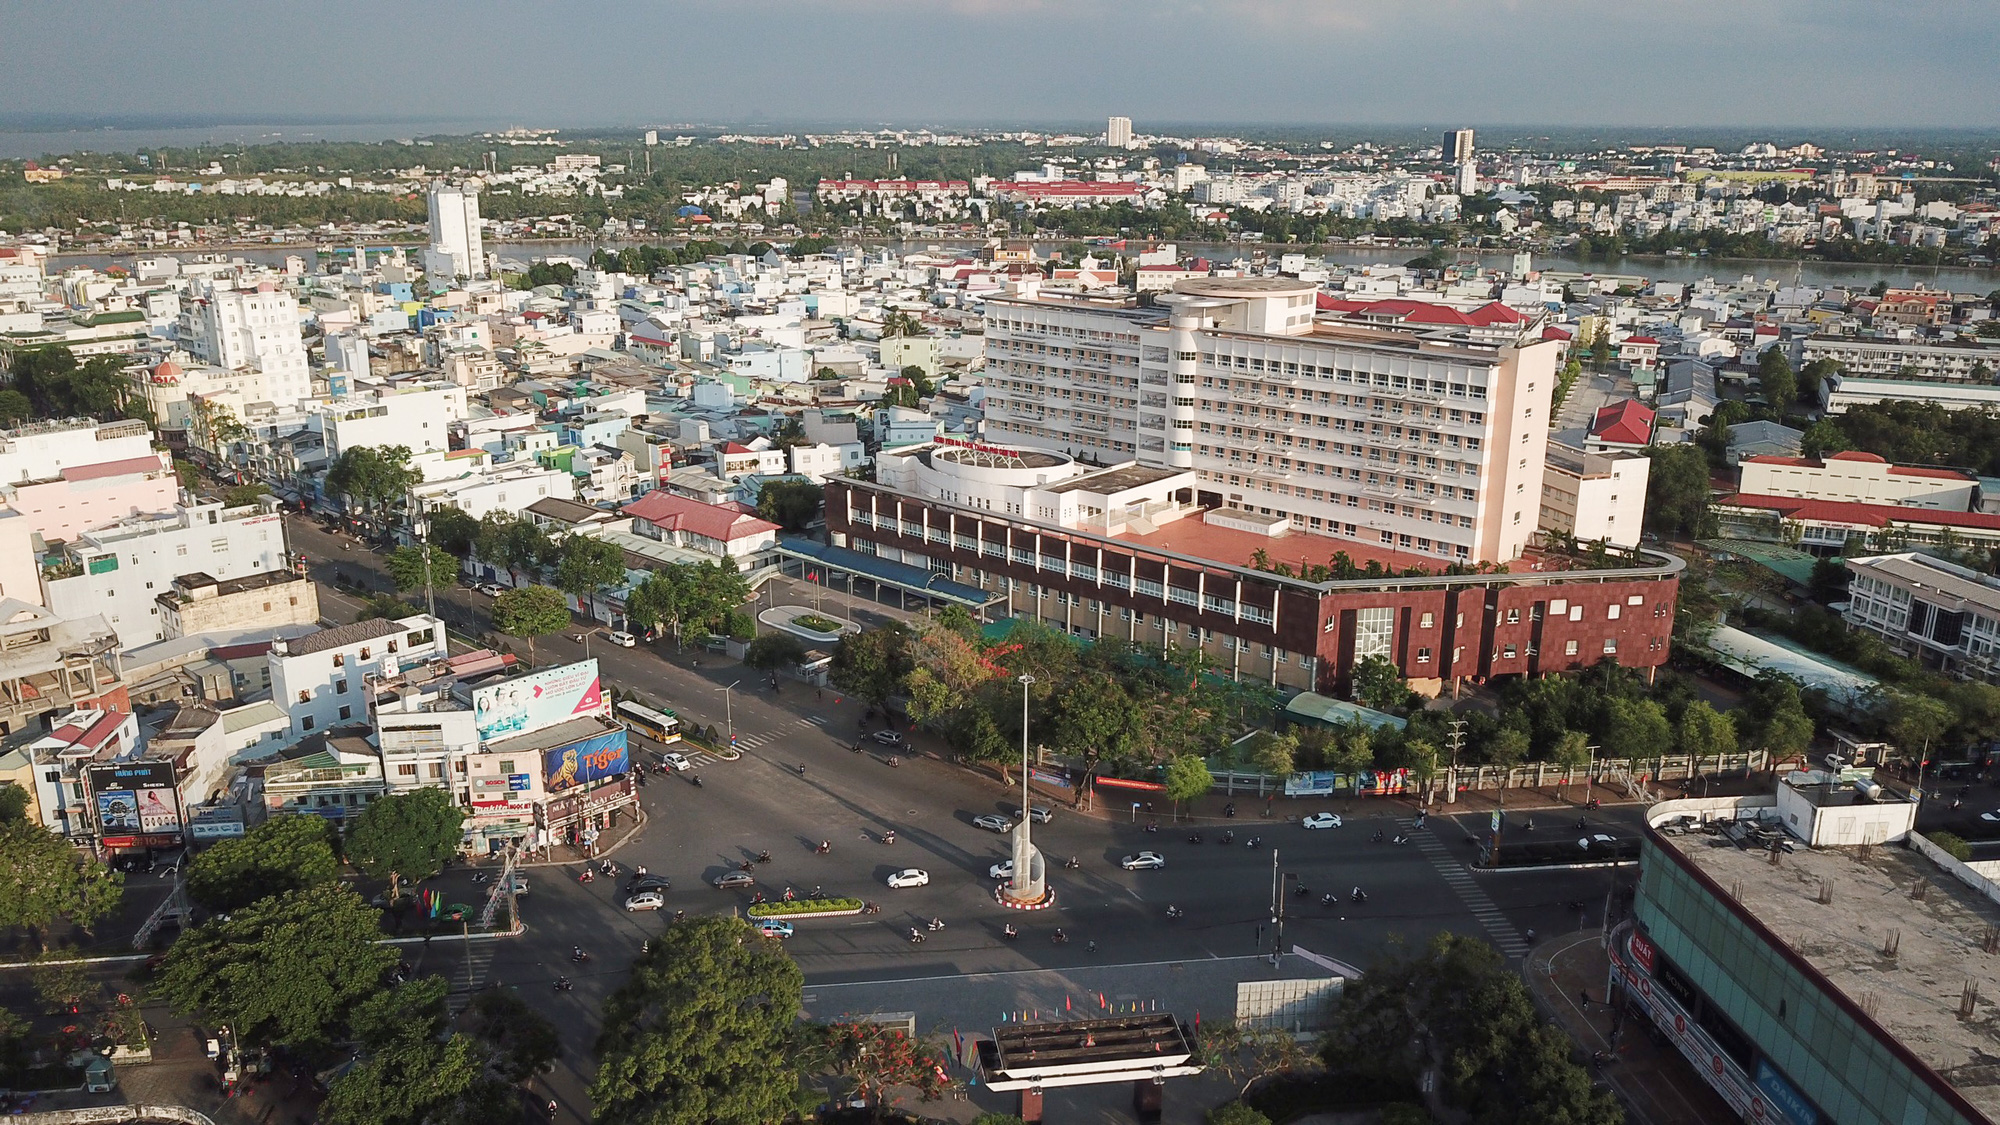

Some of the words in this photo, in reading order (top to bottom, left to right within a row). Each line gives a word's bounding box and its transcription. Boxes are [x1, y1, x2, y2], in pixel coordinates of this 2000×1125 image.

[582, 747, 624, 770] Tiger
[609, 790, 626, 801] GÒN
[1665, 971, 1690, 998] SONY
[1770, 1081, 1815, 1125] DAIKIN
